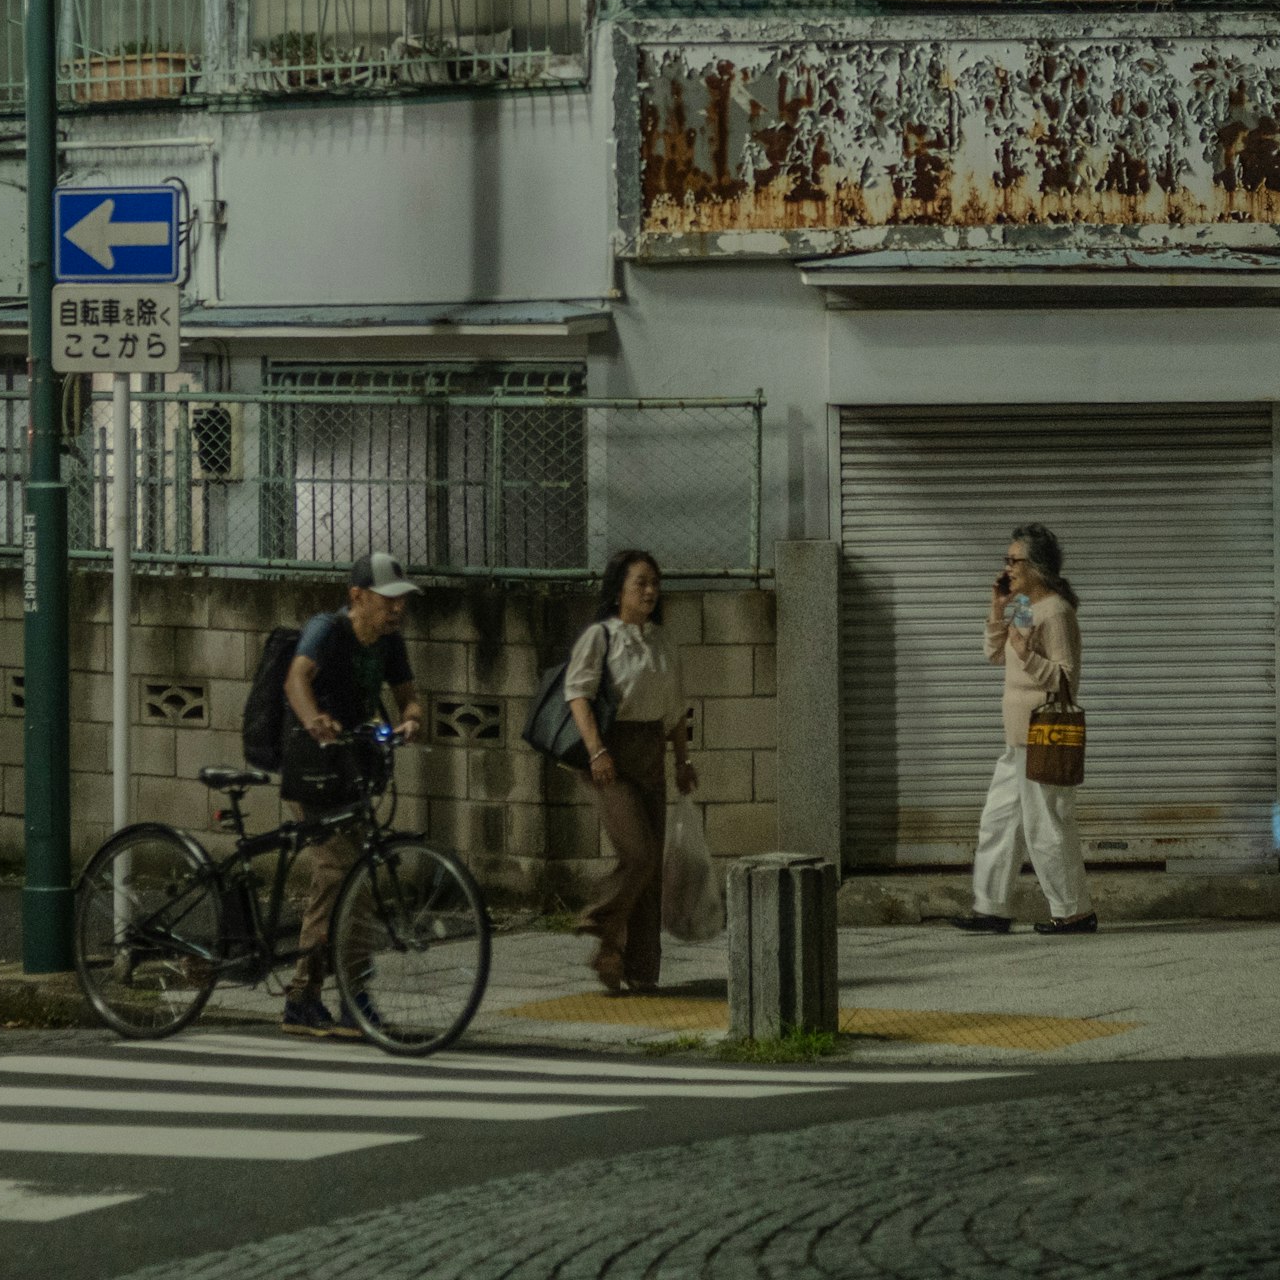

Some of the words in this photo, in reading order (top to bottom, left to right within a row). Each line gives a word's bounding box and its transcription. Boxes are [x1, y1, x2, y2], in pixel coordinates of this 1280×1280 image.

[60, 298, 172, 327] 自転車を除く
[64, 332, 166, 359] ここから
